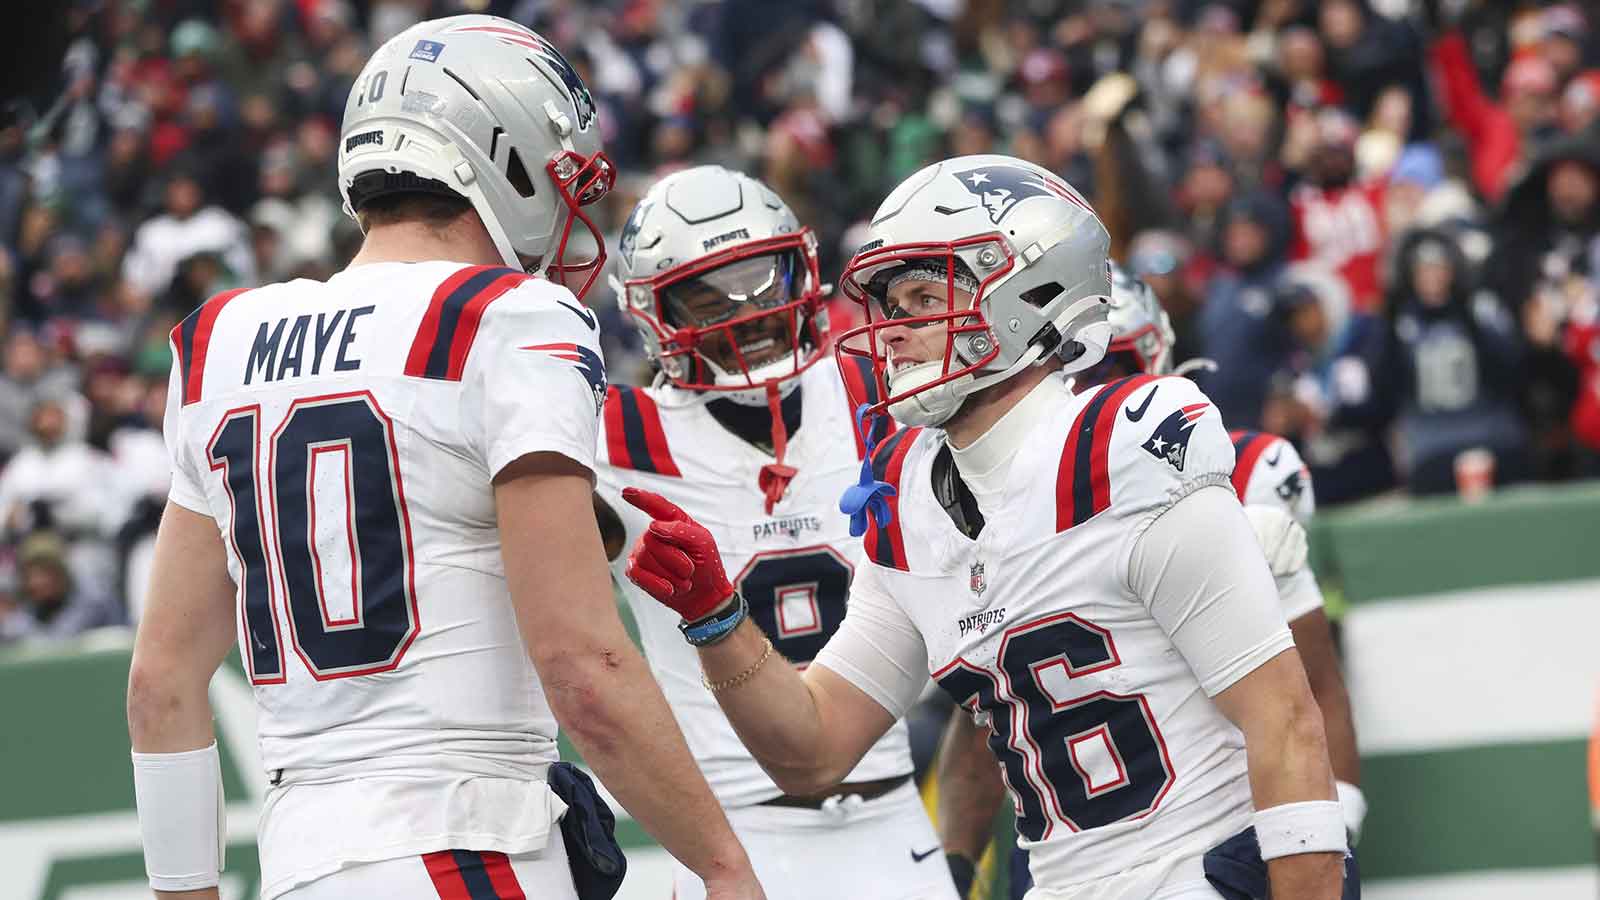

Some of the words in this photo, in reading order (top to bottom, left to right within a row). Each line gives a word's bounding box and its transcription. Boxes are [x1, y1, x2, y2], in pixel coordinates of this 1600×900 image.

[703, 227, 750, 252] PATRIOTS
[243, 304, 376, 386] MAYE
[205, 390, 421, 685] 10
[753, 516, 821, 542] PATRIOTS
[958, 607, 1006, 639] PATRIOTS
